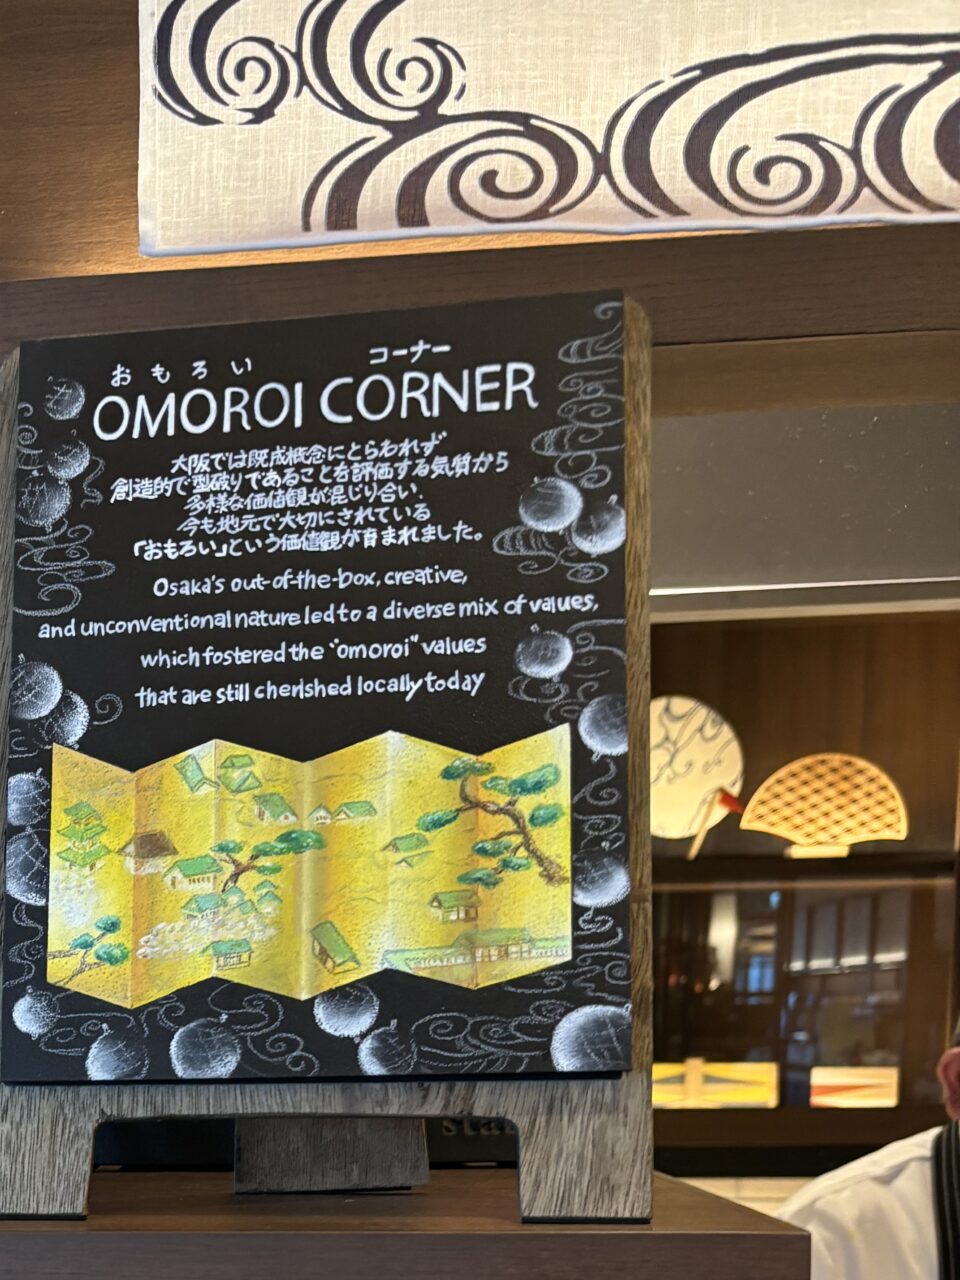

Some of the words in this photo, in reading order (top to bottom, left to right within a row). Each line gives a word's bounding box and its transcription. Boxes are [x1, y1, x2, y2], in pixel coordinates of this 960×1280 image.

[369, 339, 451, 364] コーナー
[110, 358, 252, 387] おもろい
[93, 382, 303, 441] OMOROI
[320, 362, 539, 424] CORNER
[170, 430, 448, 475] 大阪では既成概念にとらわれず
[110, 451, 509, 504] 創造的で型破りであることを評価する気質から
[177, 503, 431, 536] 今も地元で大切にされている
[133, 520, 482, 561] 「おもろい」という価値観が育まれました。
[153, 575, 225, 597] Osaka's
[231, 568, 381, 593] out-of-the-box,
[385, 566, 467, 585] creative,
[38, 618, 75, 638] and
[80, 610, 231, 636] unconventional
[235, 609, 301, 629] nature
[304, 604, 334, 624] led
[338, 603, 361, 621] to
[367, 606, 376, 621] a
[383, 600, 455, 620] diverse
[459, 598, 499, 617] mix
[504, 594, 525, 615] of
[530, 594, 598, 613] values,
[141, 646, 200, 668] which
[203, 641, 285, 666] fostered
[289, 642, 324, 663] the
[329, 634, 419, 659] "omoroi"
[421, 637, 487, 655] values
[135, 686, 177, 708] that
[181, 687, 211, 705] are
[216, 683, 250, 703] still
[254, 675, 352, 699] cherished
[358, 674, 423, 702] locally
[423, 670, 485, 697] today
